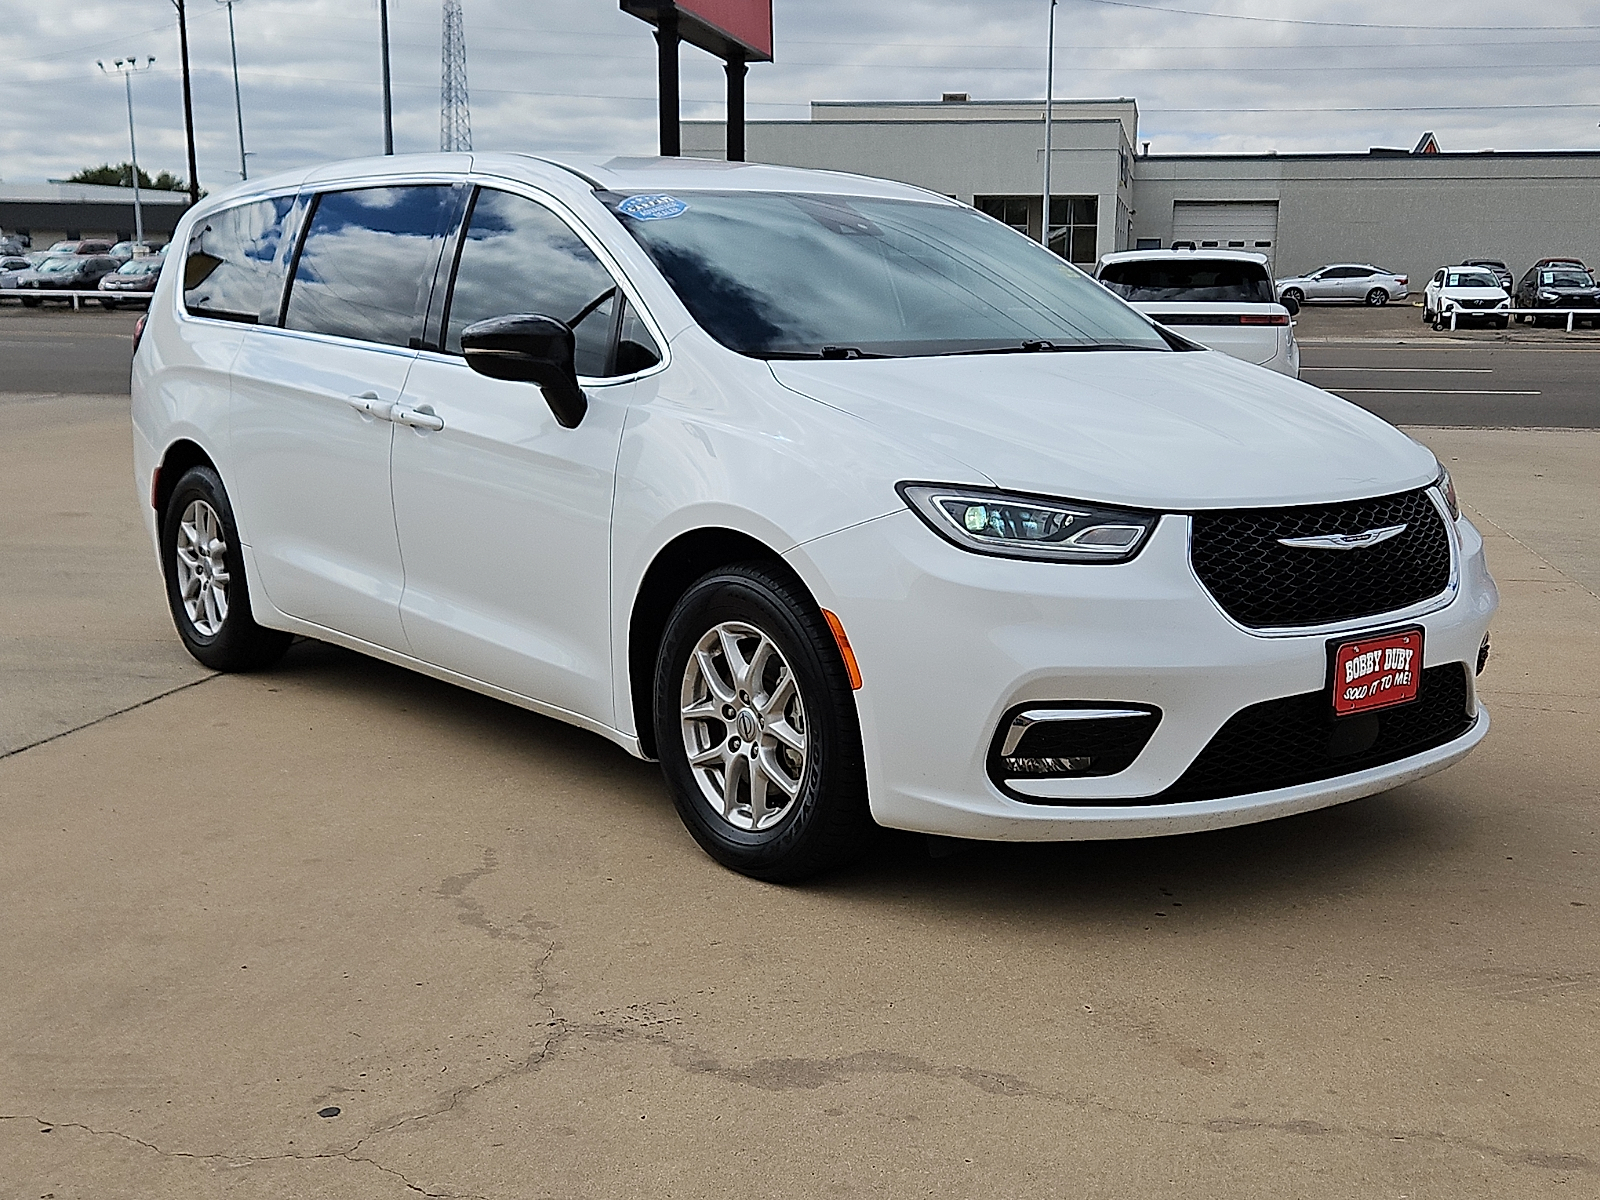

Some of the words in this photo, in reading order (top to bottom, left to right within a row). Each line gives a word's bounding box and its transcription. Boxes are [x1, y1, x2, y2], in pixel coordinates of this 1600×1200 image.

[1345, 650, 1382, 683] BOBBY
[1384, 648, 1414, 671] DUBY
[1343, 685, 1368, 700] SOLD
[1369, 680, 1380, 696] IT
[1381, 674, 1393, 691] TO
[1394, 671, 1412, 686] ME!
